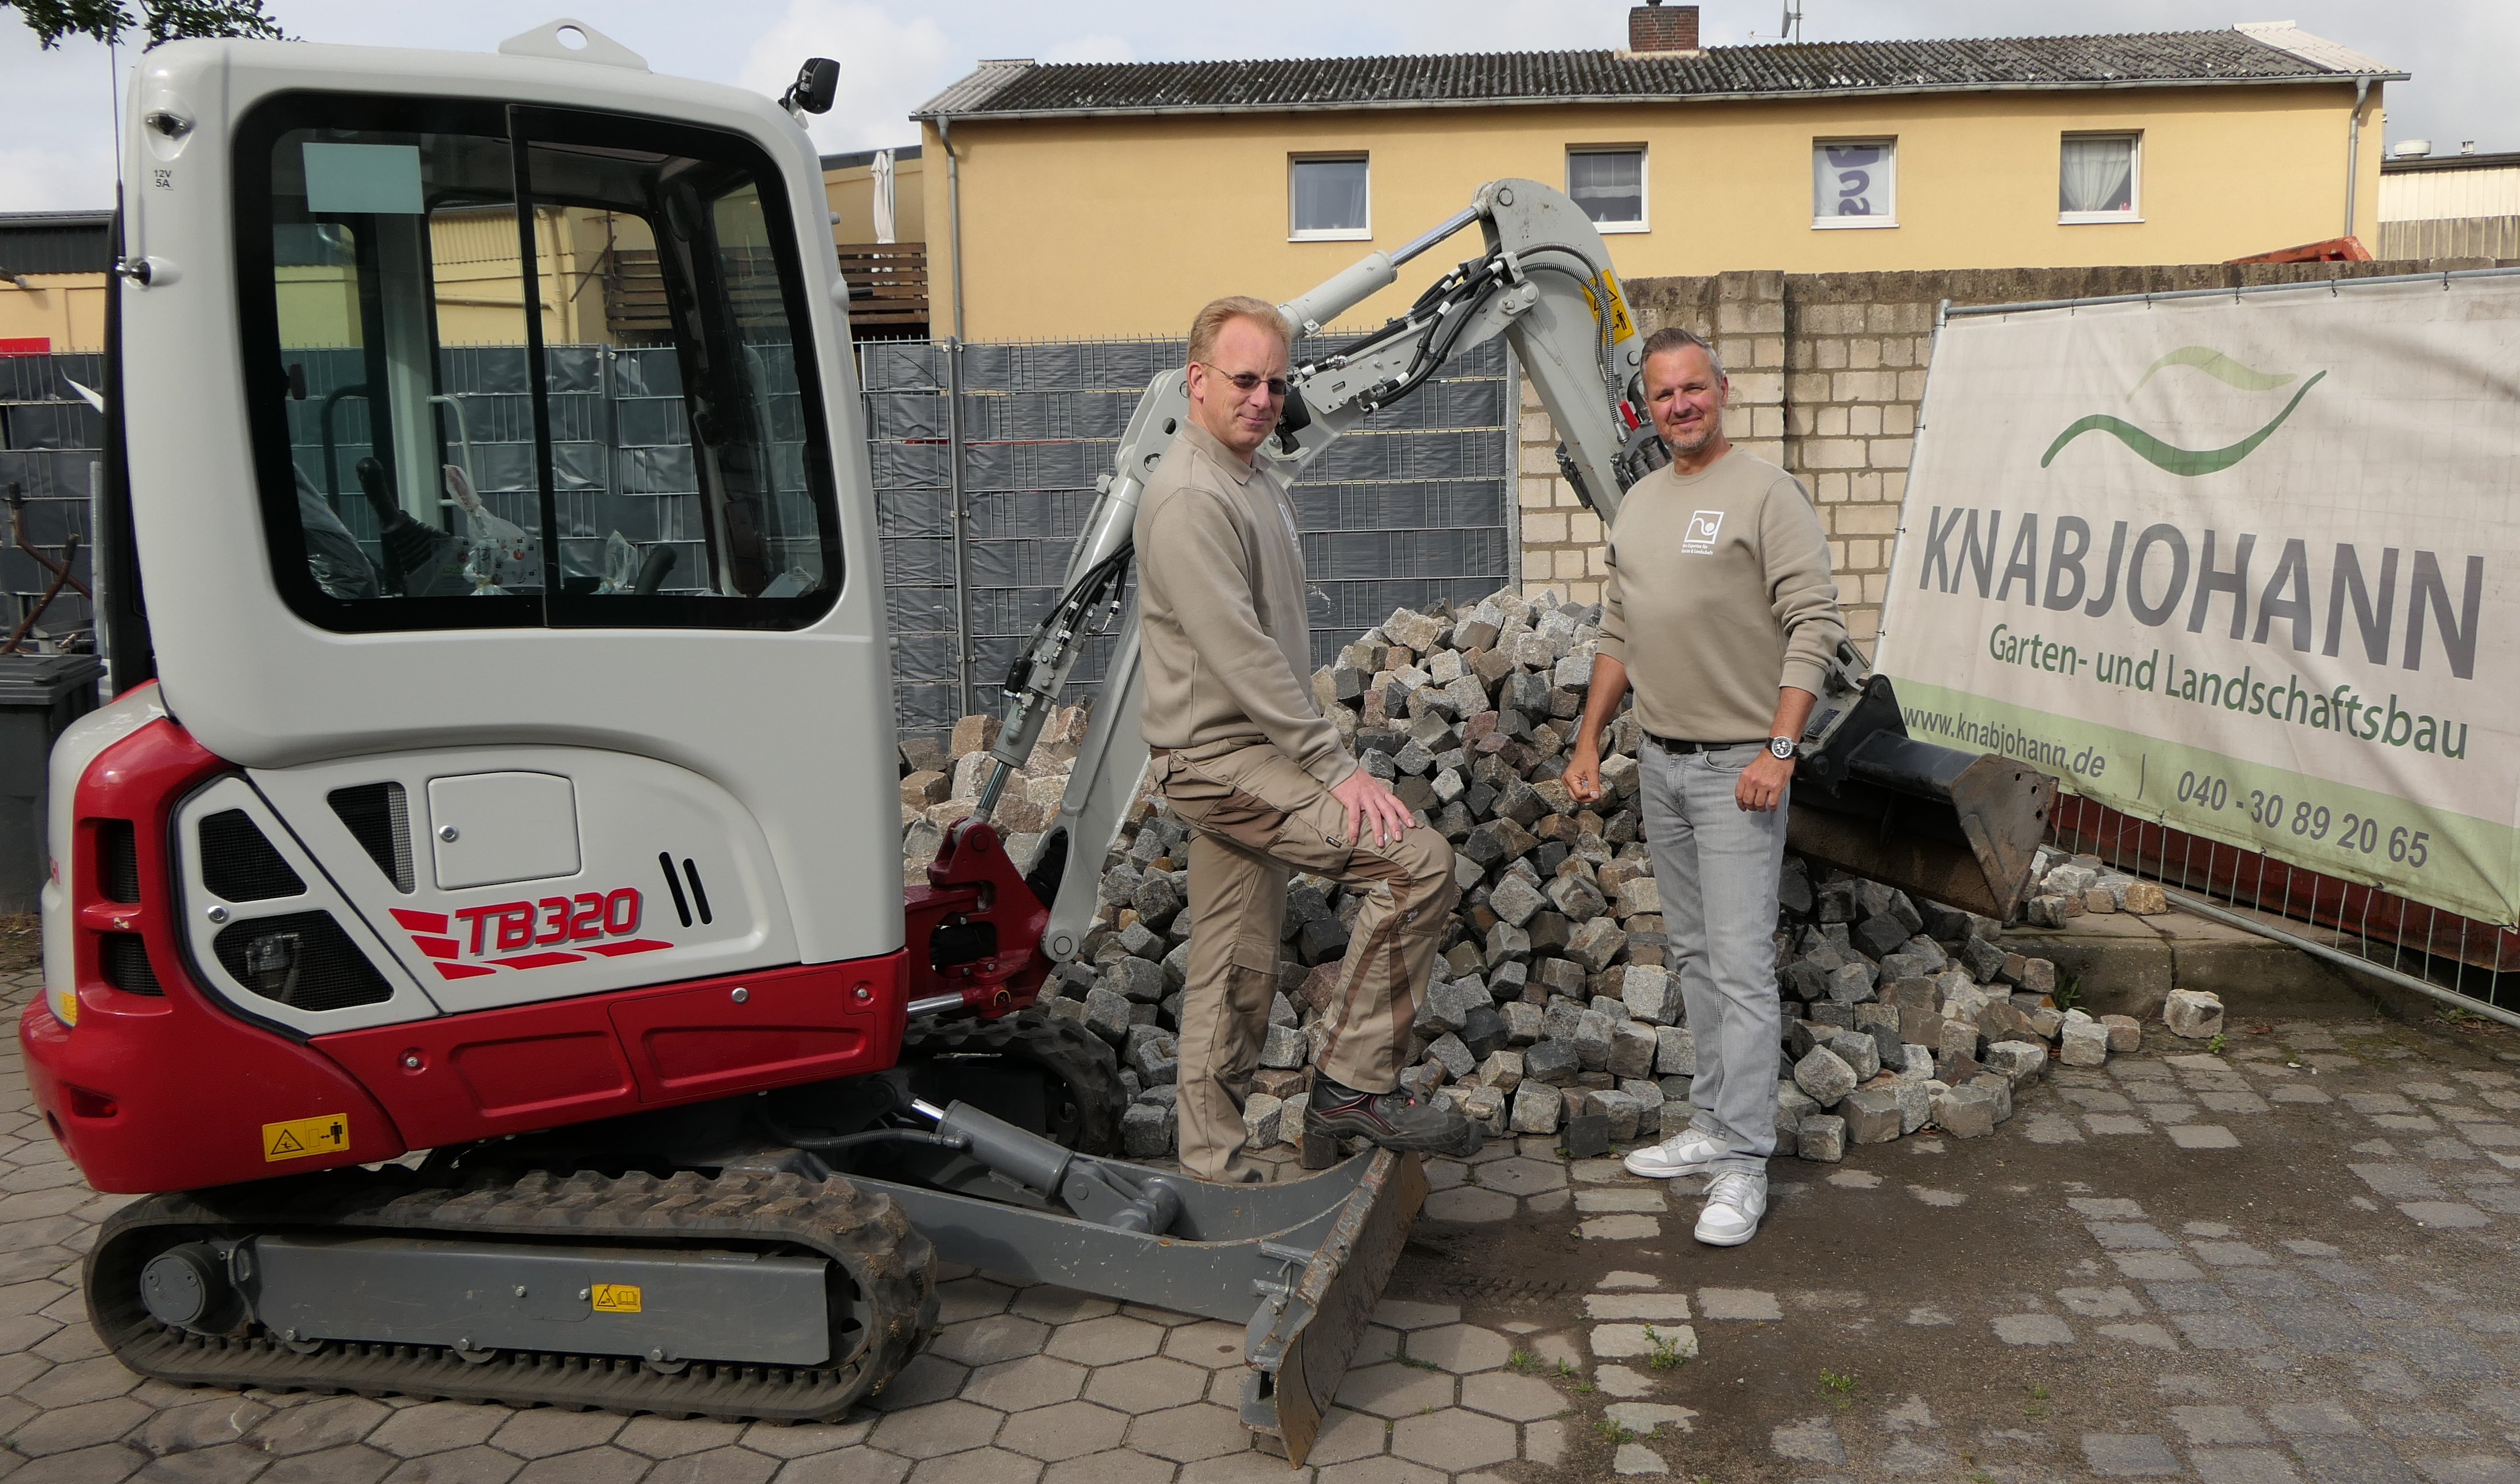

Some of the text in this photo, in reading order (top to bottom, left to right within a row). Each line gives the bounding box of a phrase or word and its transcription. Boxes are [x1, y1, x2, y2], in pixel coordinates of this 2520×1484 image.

[153, 169, 172, 178] 12V
[156, 179, 171, 187] 5A
[1919, 506, 2484, 680] KNABJOHANN
[1990, 623, 2467, 759] Garten- und Landschaftsbau
[1904, 707, 2105, 778] www.knabjohann.de
[2178, 771, 2227, 810] 040
[2250, 789, 2283, 828] 30
[2291, 801, 2330, 840] 89
[2337, 813, 2377, 854] 20
[2388, 826, 2430, 868] 65
[455, 887, 643, 956] TB320
